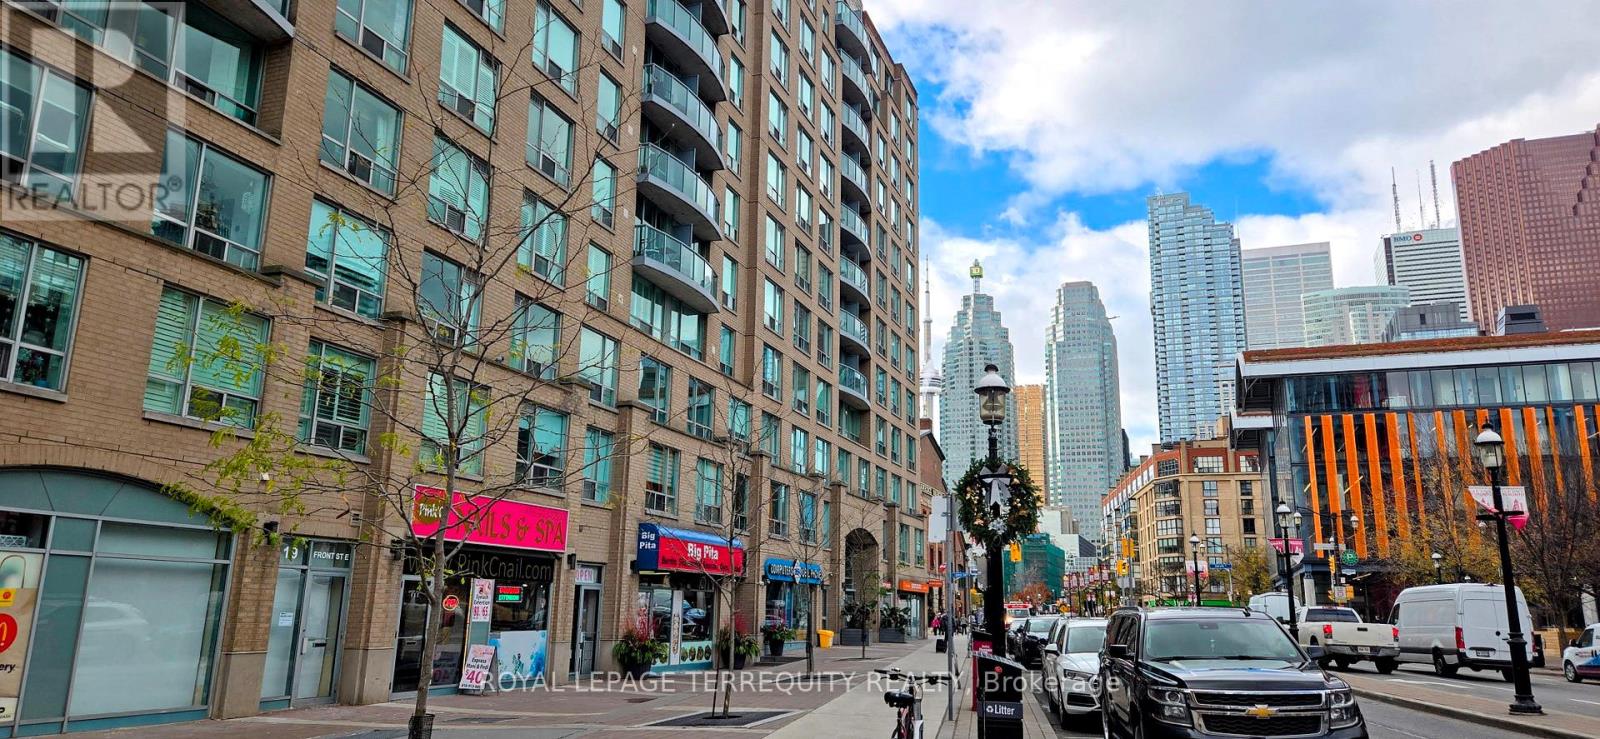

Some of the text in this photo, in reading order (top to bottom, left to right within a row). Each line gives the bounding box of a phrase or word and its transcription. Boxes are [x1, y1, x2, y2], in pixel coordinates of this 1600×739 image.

[456, 507, 564, 545] NAILS & SPA
[641, 531, 656, 541] Big
[639, 541, 656, 550] Pita
[283, 546, 298, 559] 19
[313, 551, 335, 560] FRONT
[336, 552, 344, 560] ST
[687, 543, 719, 561] Big Pita
[994, 704, 1015, 715] Litter
